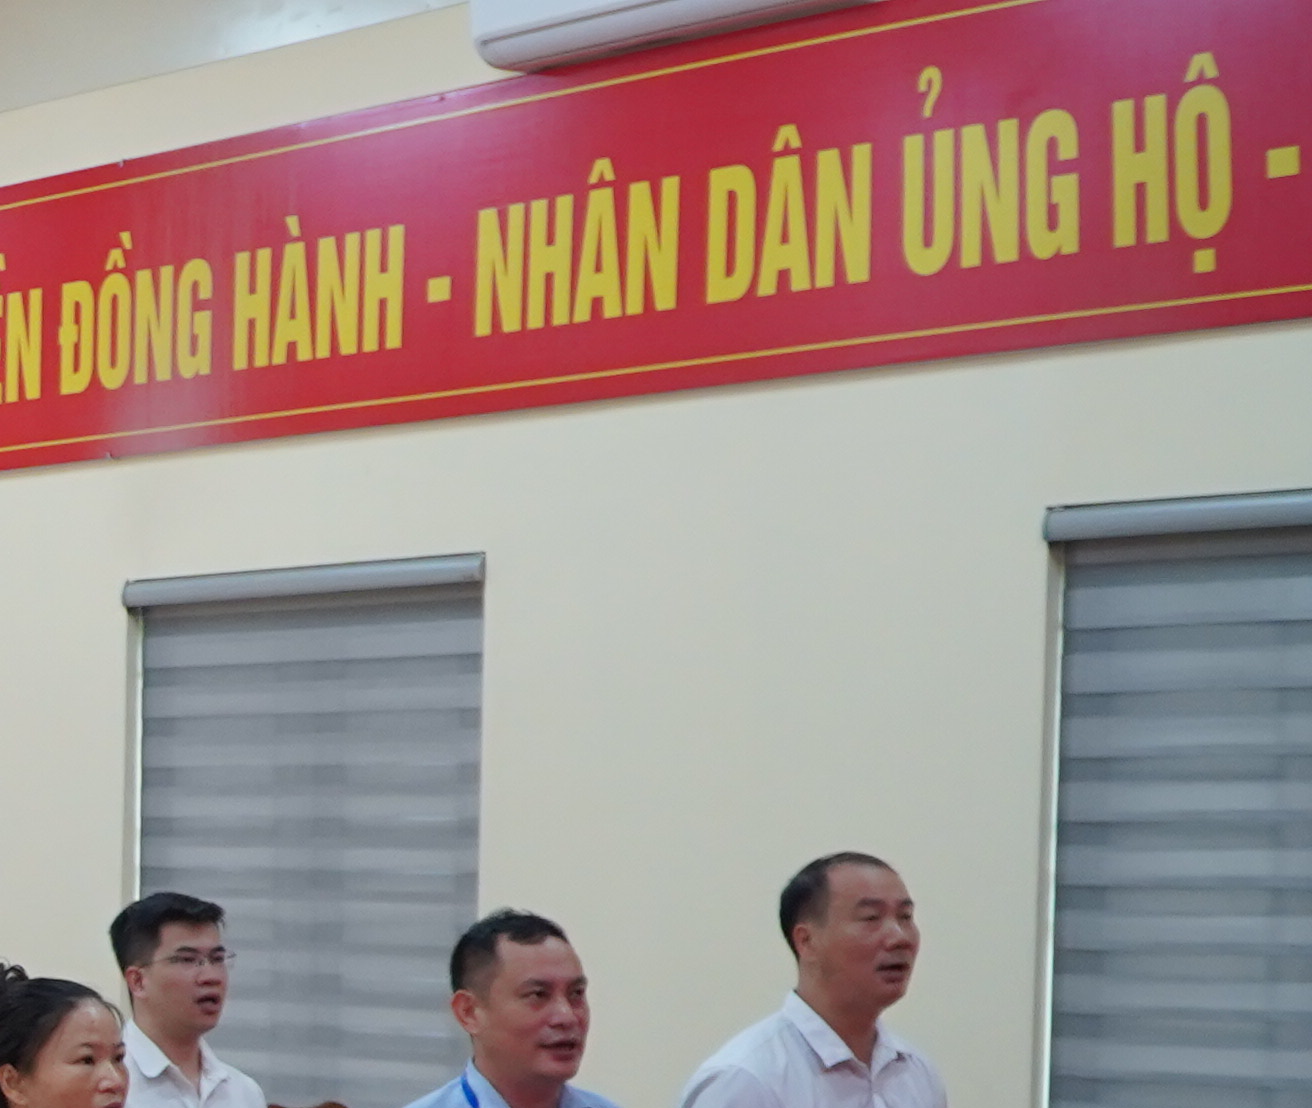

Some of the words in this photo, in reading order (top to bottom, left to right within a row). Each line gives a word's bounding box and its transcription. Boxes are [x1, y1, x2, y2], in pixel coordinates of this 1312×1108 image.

[56, 229, 215, 396] ĐỒNG
[230, 214, 406, 372] HÀNH
[425, 274, 453, 304] -
[473, 156, 681, 338] NHÂN
[704, 122, 874, 305] DÂN
[901, 64, 1081, 277] ỦNG
[1110, 51, 1233, 274] HỘ
[1265, 144, 1301, 180] -
